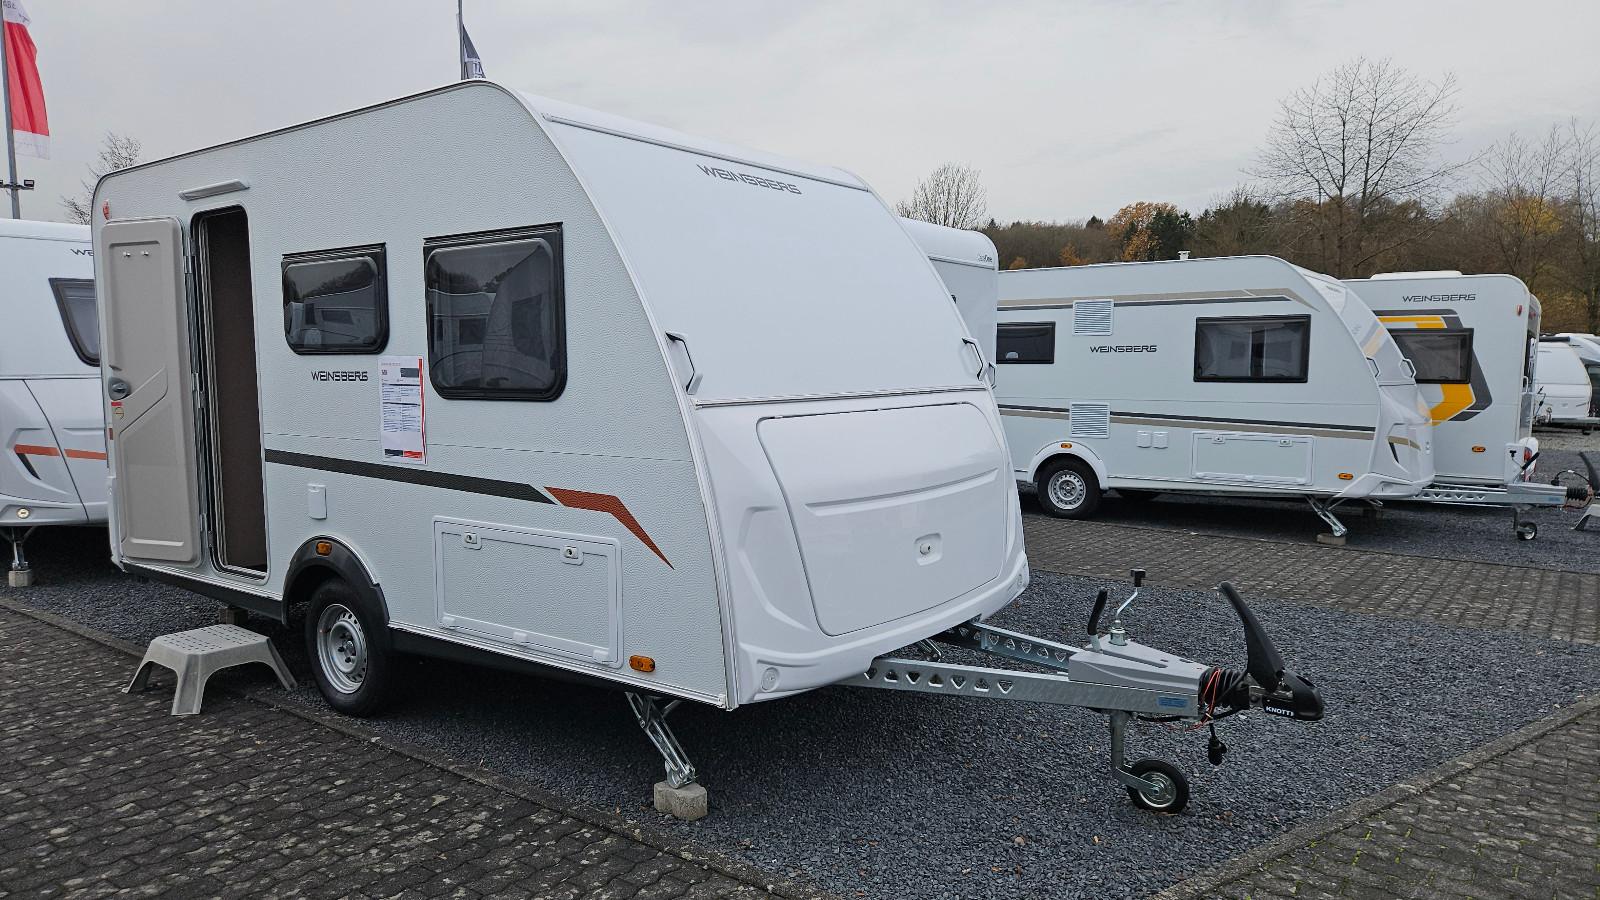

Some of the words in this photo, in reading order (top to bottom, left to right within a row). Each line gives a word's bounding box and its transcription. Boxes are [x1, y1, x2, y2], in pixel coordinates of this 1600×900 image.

[696, 164, 802, 194] WEINSBERG
[1402, 294, 1476, 302] WEINSBERG
[1089, 345, 1158, 353] WEINSBERG
[311, 371, 368, 381] WEINSBERG
